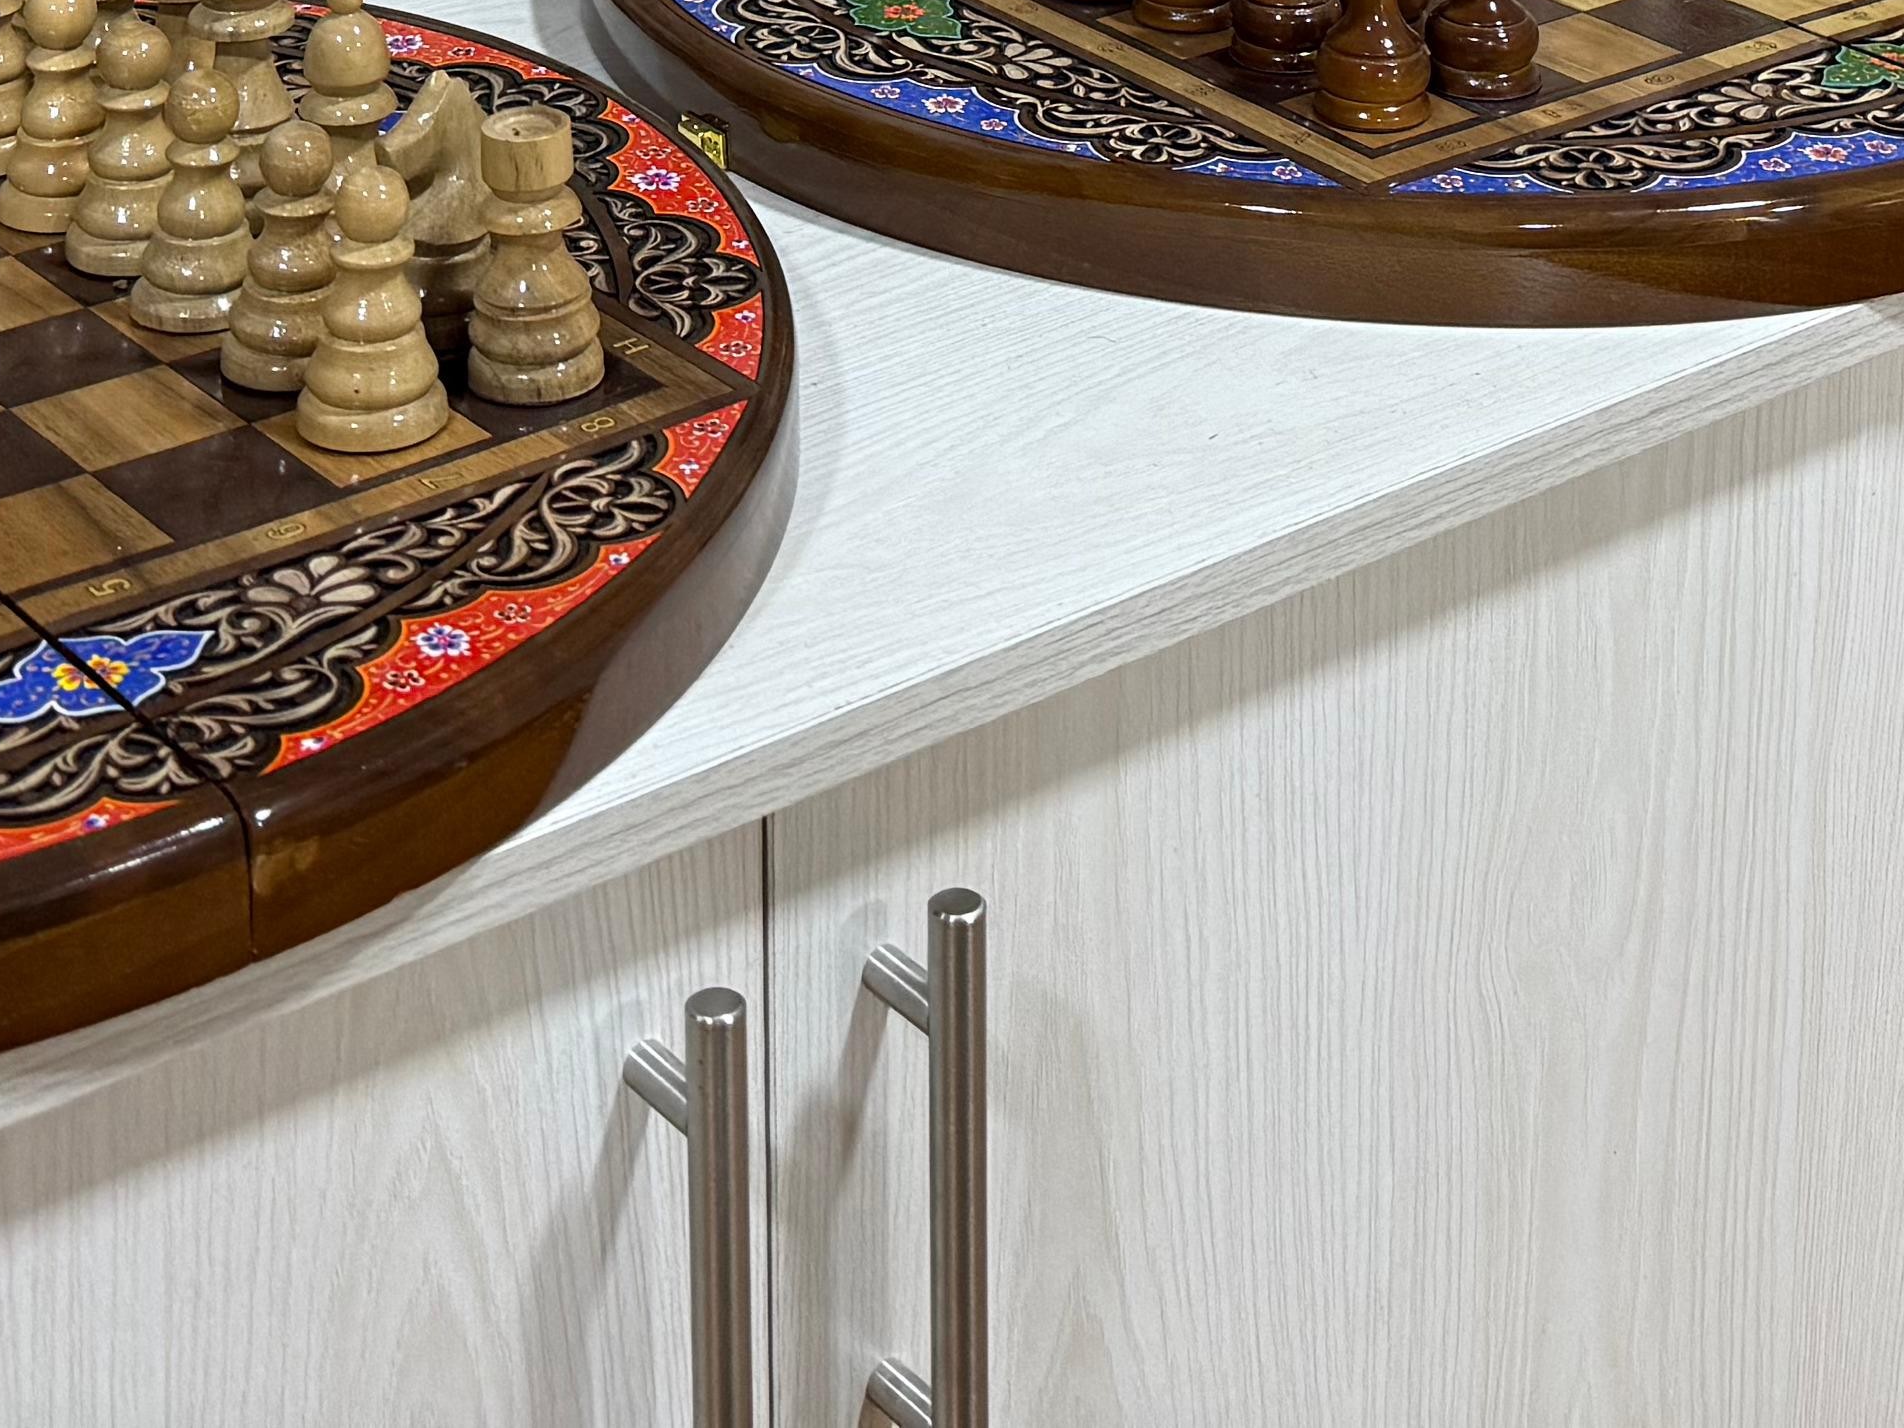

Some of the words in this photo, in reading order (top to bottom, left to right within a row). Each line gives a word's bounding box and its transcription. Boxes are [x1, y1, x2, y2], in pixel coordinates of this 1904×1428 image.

[611, 336, 650, 357] H
[87, 578, 131, 597] 5
[581, 415, 617, 433] 8
